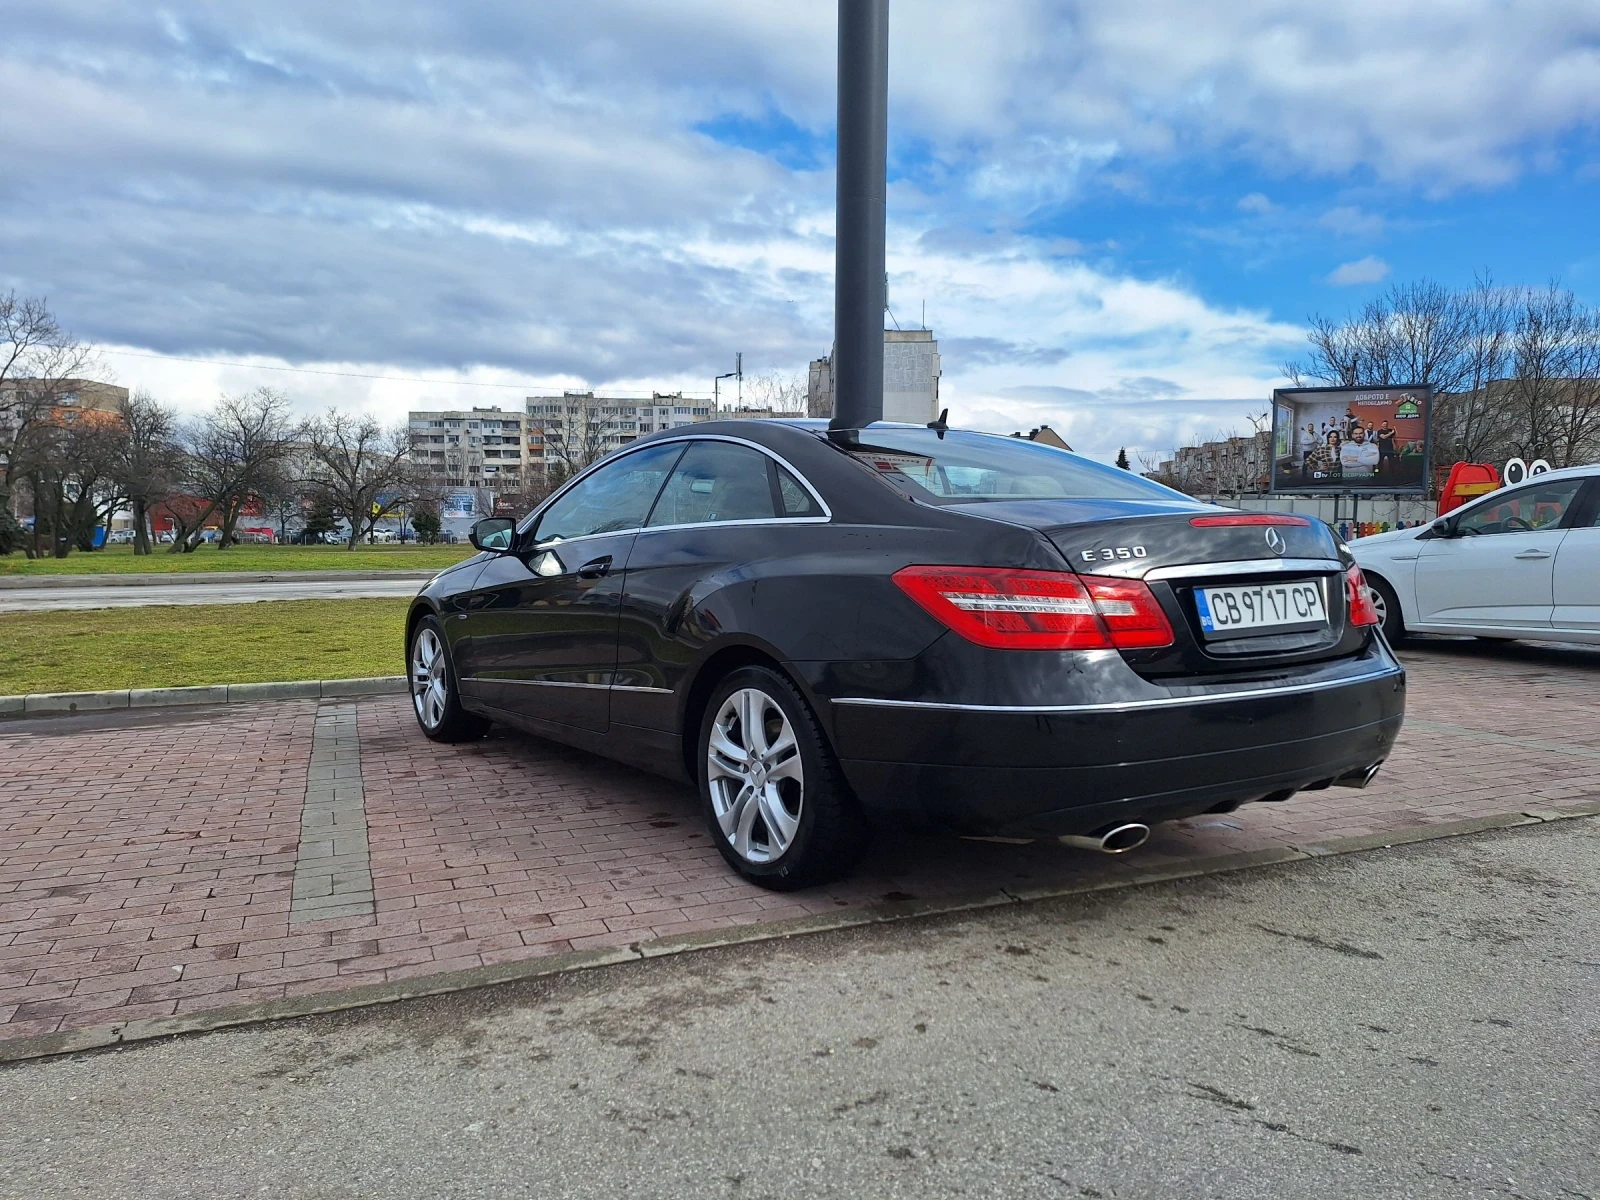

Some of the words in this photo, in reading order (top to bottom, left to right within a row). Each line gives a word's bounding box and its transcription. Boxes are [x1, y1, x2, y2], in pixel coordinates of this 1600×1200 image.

[1081, 549, 1097, 562] E
[1100, 546, 1147, 560] 350
[1201, 616, 1212, 626] BG
